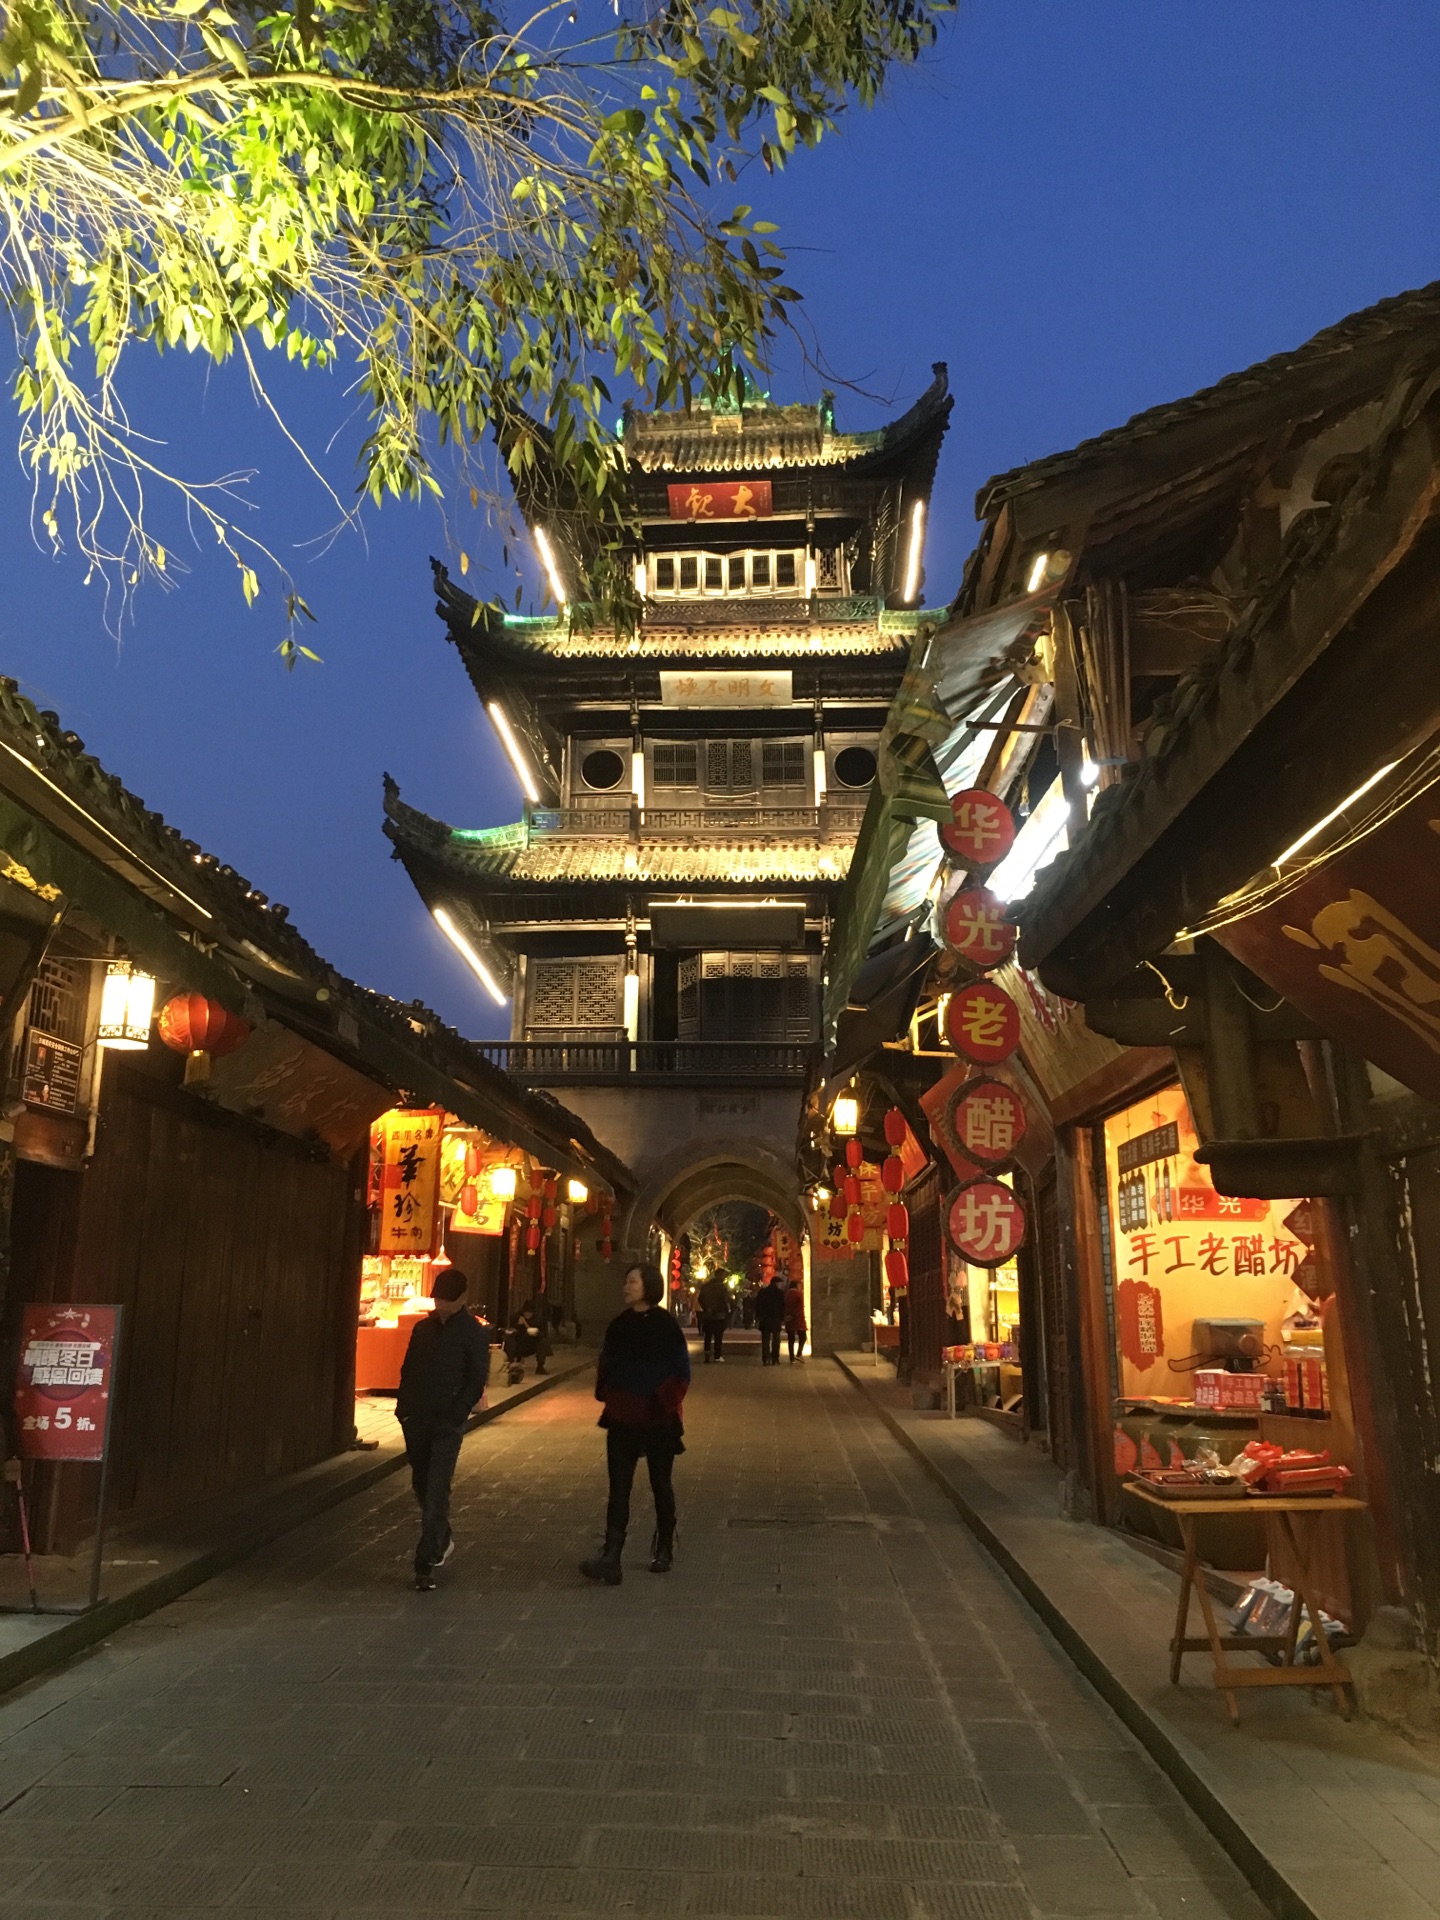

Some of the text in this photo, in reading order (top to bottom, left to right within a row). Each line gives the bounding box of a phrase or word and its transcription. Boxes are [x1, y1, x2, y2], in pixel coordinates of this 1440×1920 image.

[1181, 1194, 1242, 1214] 华光
[391, 1225, 422, 1240] 牛肉
[1128, 1231, 1300, 1277] 手工老醋坊
[30, 1367, 104, 1387] 感恩回馈
